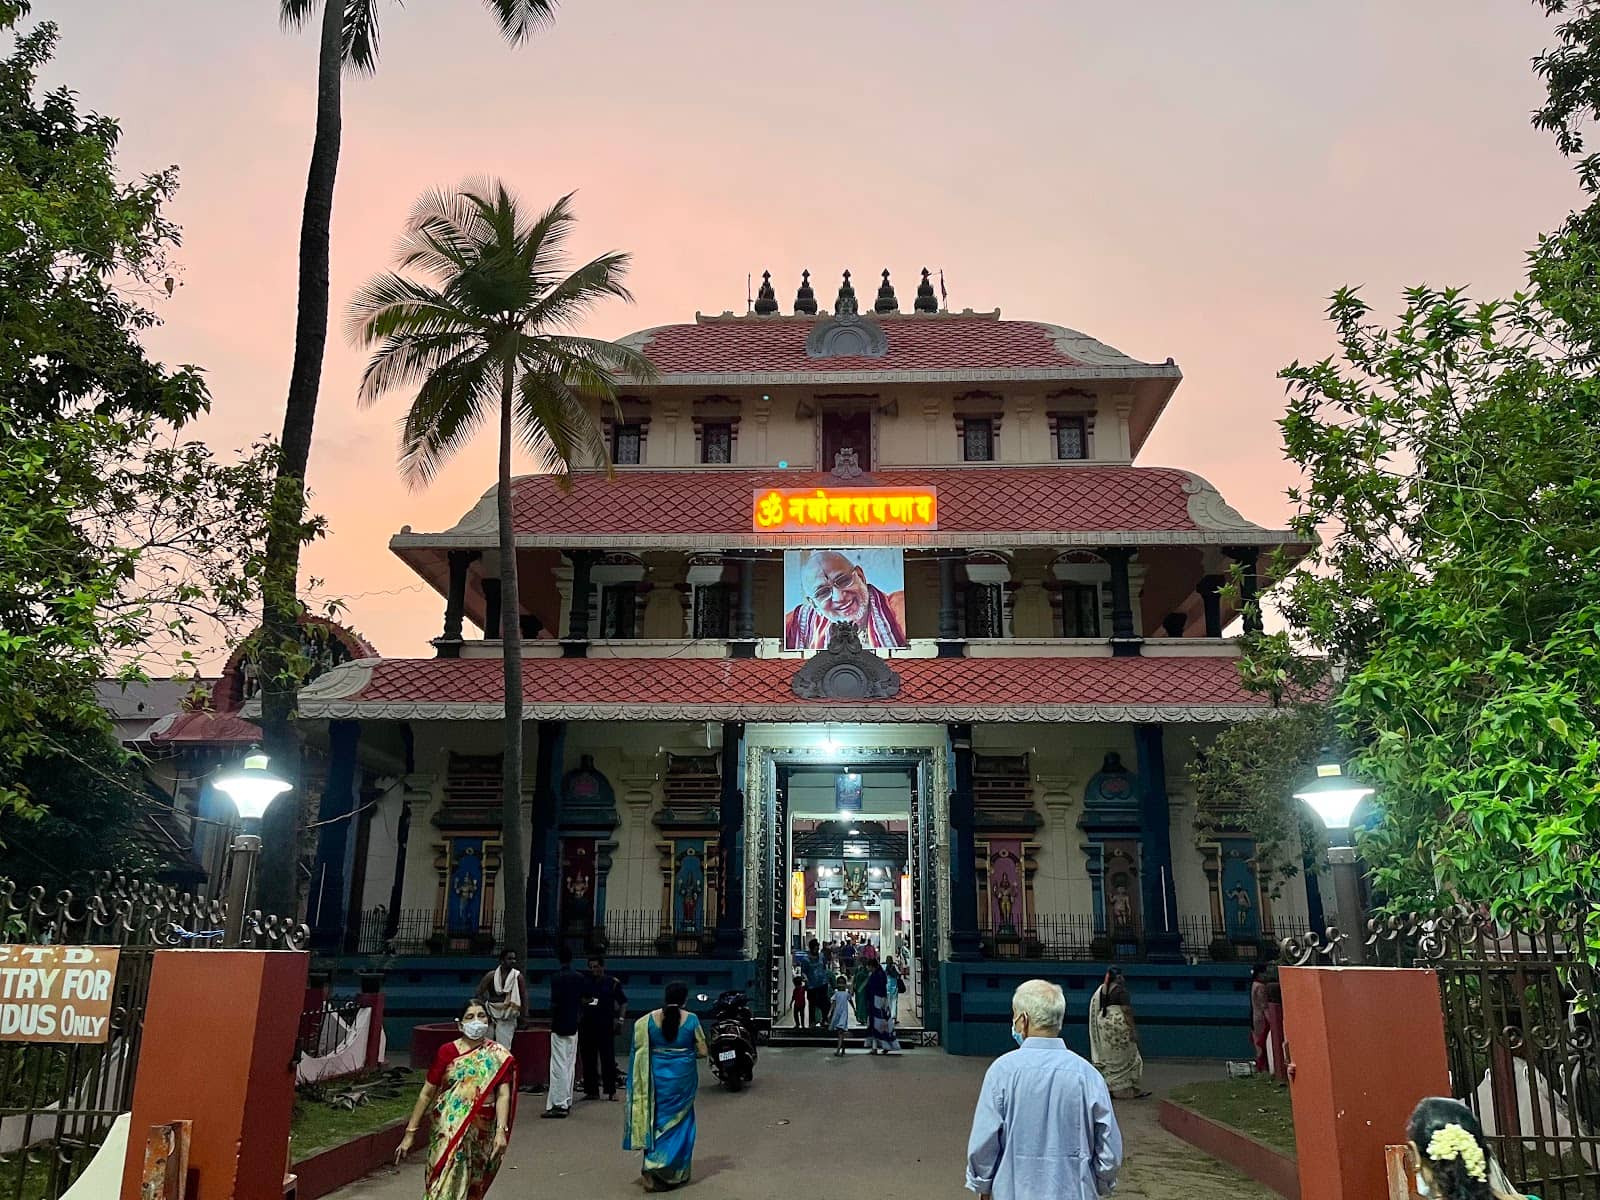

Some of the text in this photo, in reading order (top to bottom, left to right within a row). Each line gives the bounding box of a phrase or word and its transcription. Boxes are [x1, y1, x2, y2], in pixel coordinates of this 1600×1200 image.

[0, 967, 112, 1001] TRY FOR
[0, 1003, 107, 1037] DUS ONLY
